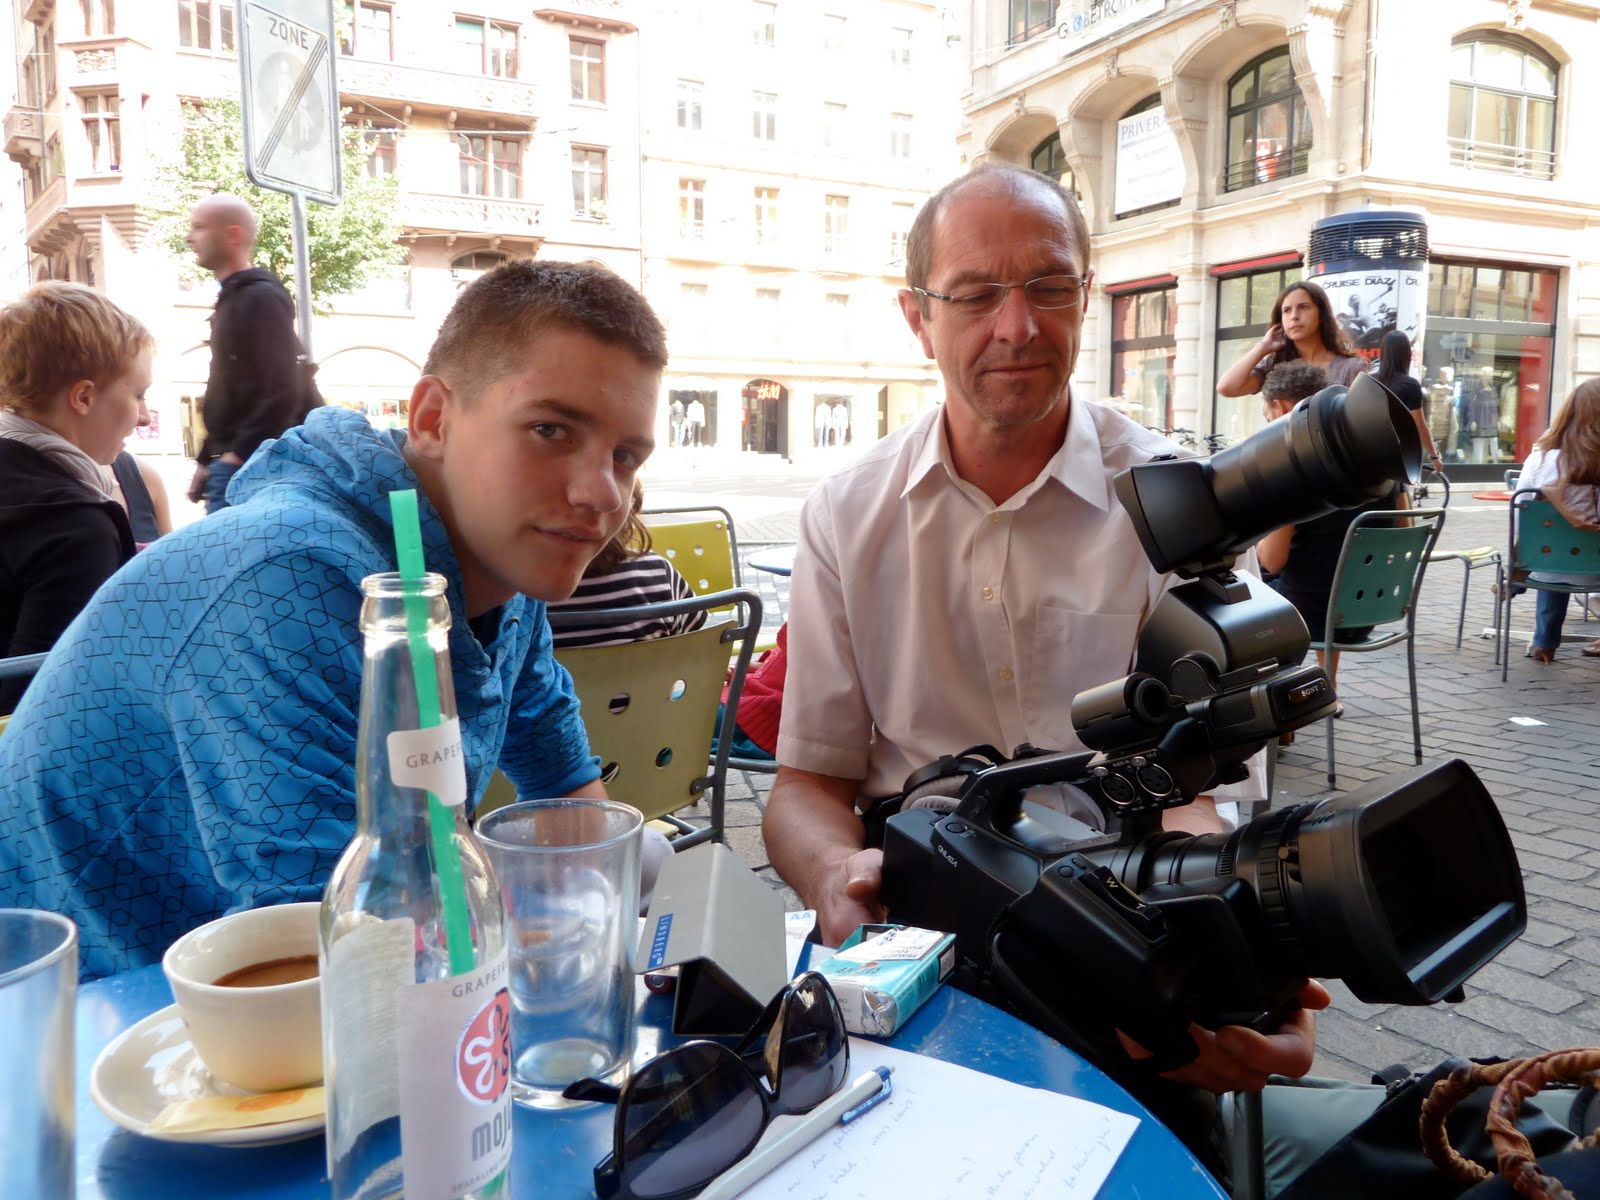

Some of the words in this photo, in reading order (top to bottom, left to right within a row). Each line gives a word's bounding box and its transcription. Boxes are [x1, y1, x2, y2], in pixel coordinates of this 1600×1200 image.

[268, 16, 309, 50] ZONE
[1322, 278, 1360, 290] CRUISE
[1364, 276, 1393, 287] DIAZ
[757, 381, 781, 400] H&M
[1301, 684, 1320, 697] SONY
